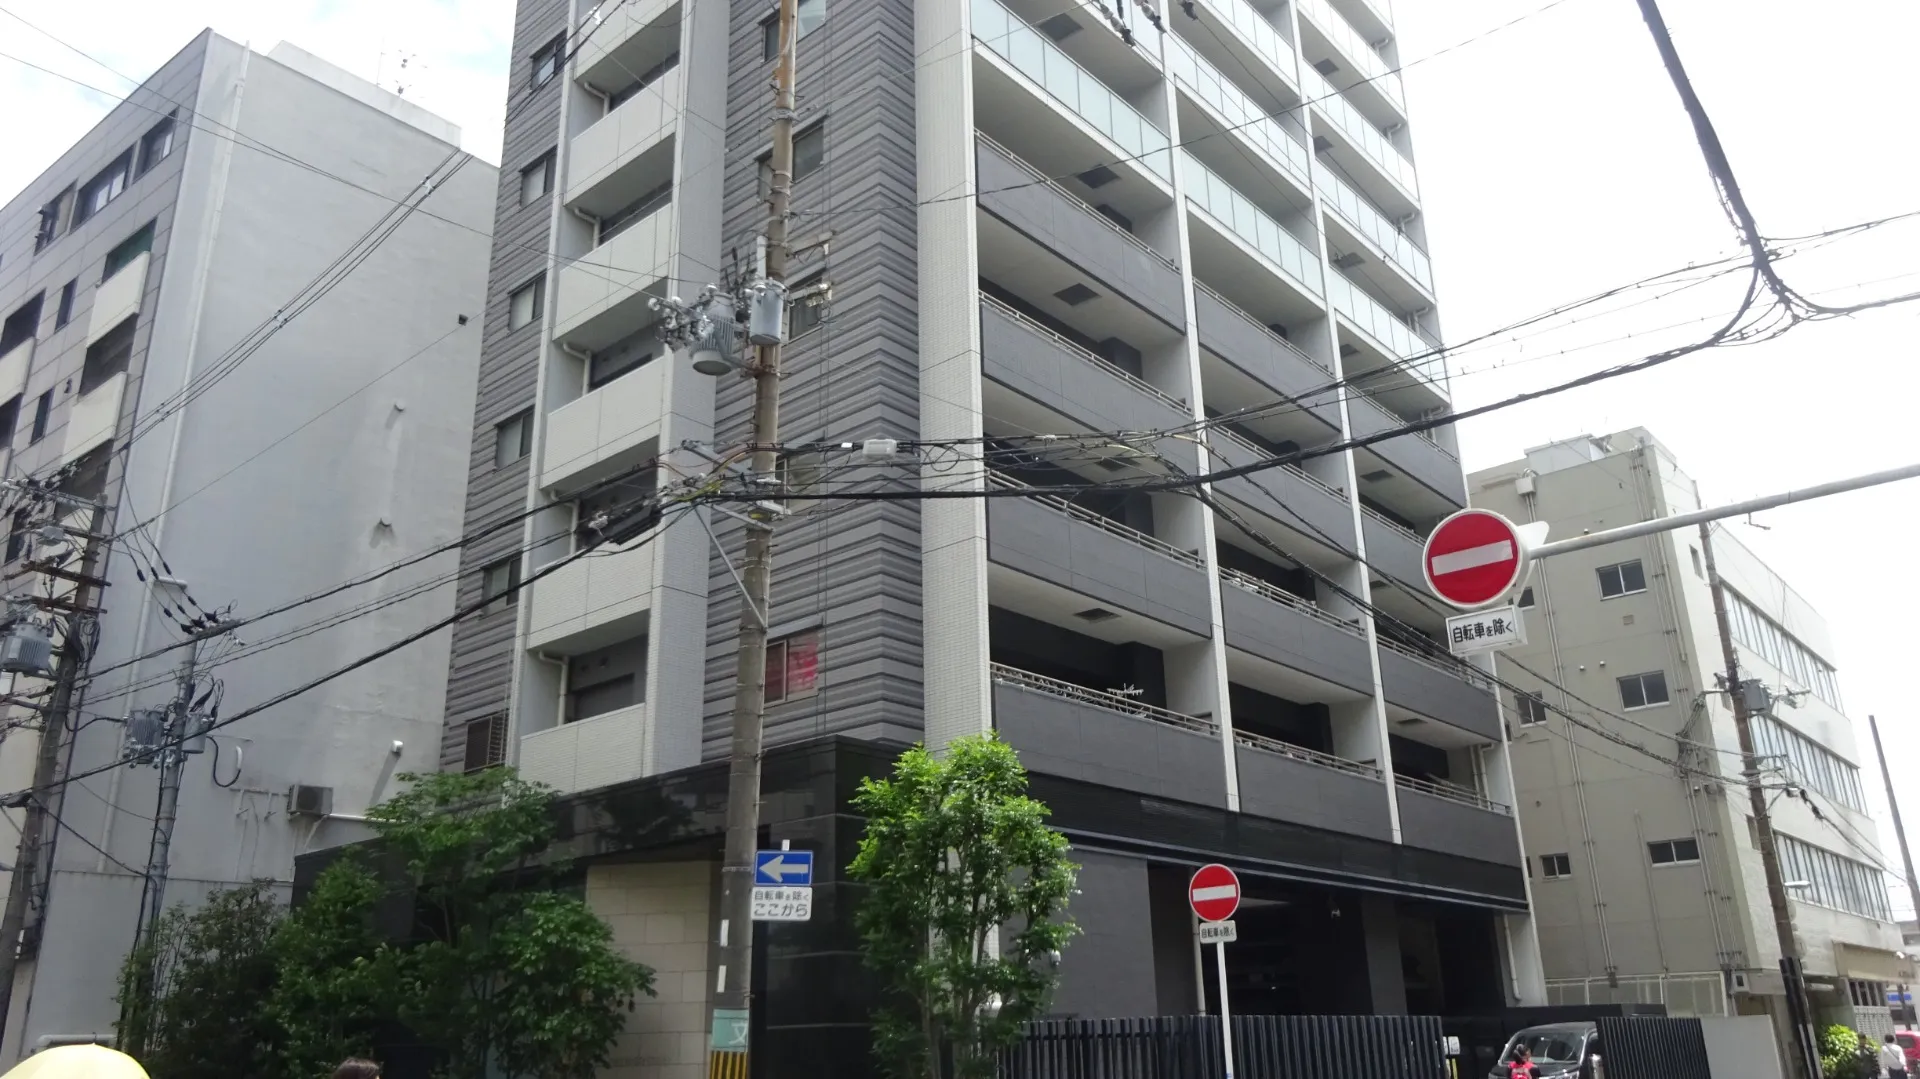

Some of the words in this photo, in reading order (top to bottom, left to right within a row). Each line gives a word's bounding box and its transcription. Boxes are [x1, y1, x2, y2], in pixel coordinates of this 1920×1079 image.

[1452, 618, 1513, 643] 自転車を除く
[755, 890, 809, 901] 自転車を除く
[754, 903, 808, 917] ここから
[1201, 926, 1234, 938] 自転車を除く
